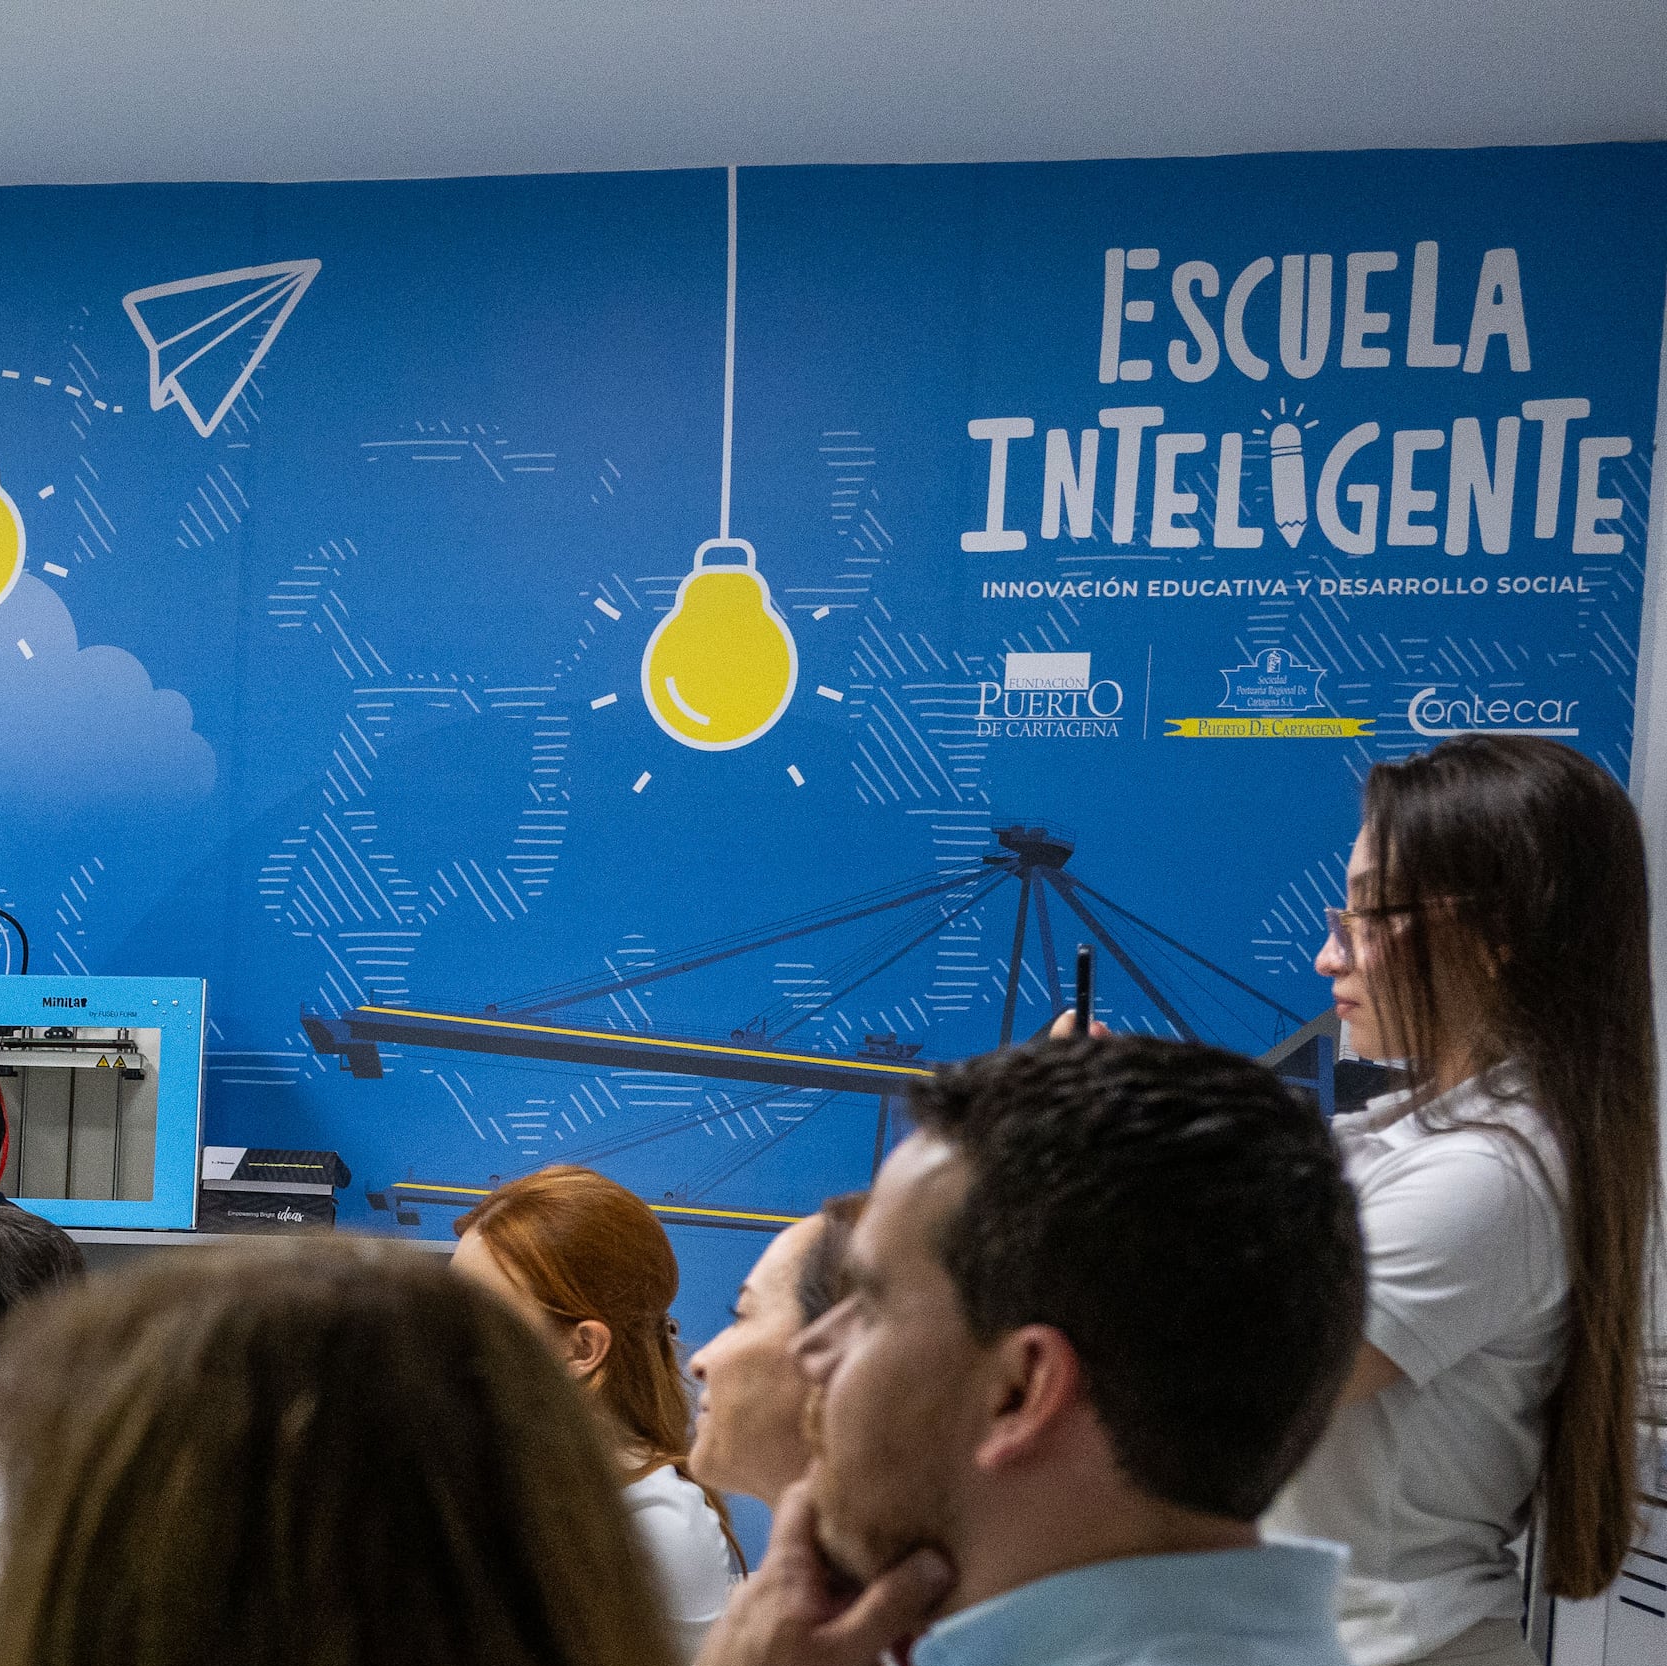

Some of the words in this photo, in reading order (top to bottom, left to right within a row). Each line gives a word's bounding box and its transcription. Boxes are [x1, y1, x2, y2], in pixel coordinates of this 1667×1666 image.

[1099, 241, 1530, 383] ESCUELA
[961, 398, 1631, 556] INTELIGENTE
[982, 576, 1139, 599] INNOVACIÓN
[1147, 579, 1288, 598] EDUCATIVA
[1296, 579, 1313, 597] Y
[1320, 577, 1488, 598] DESARROLLO
[1497, 576, 1589, 596] SOCIAL
[1008, 677, 1085, 689] FUNDACIÓN
[976, 680, 1124, 718] PUERTO
[1408, 687, 1580, 735] Contecar
[977, 722, 1003, 738] DE
[1006, 721, 1120, 738] CARTAGENA
[277, 1205, 305, 1222] ideas
